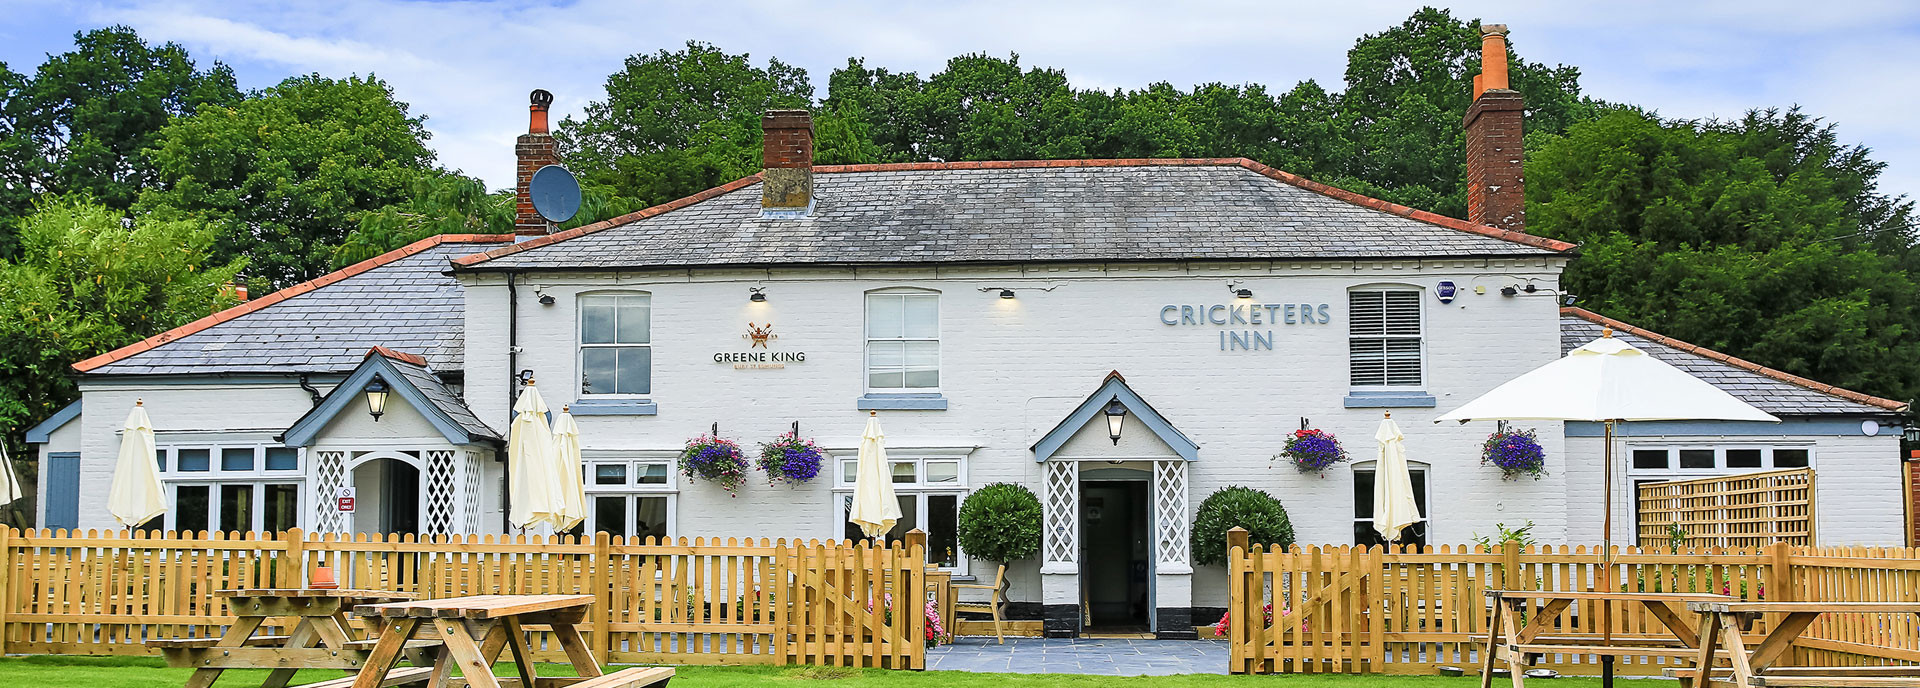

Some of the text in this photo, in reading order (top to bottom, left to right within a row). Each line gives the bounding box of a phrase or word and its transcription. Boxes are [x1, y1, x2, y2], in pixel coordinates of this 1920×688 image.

[1160, 304, 1330, 326] CRICKETERS
[1219, 330, 1273, 351] INN
[713, 352, 806, 363] GREENE KING
